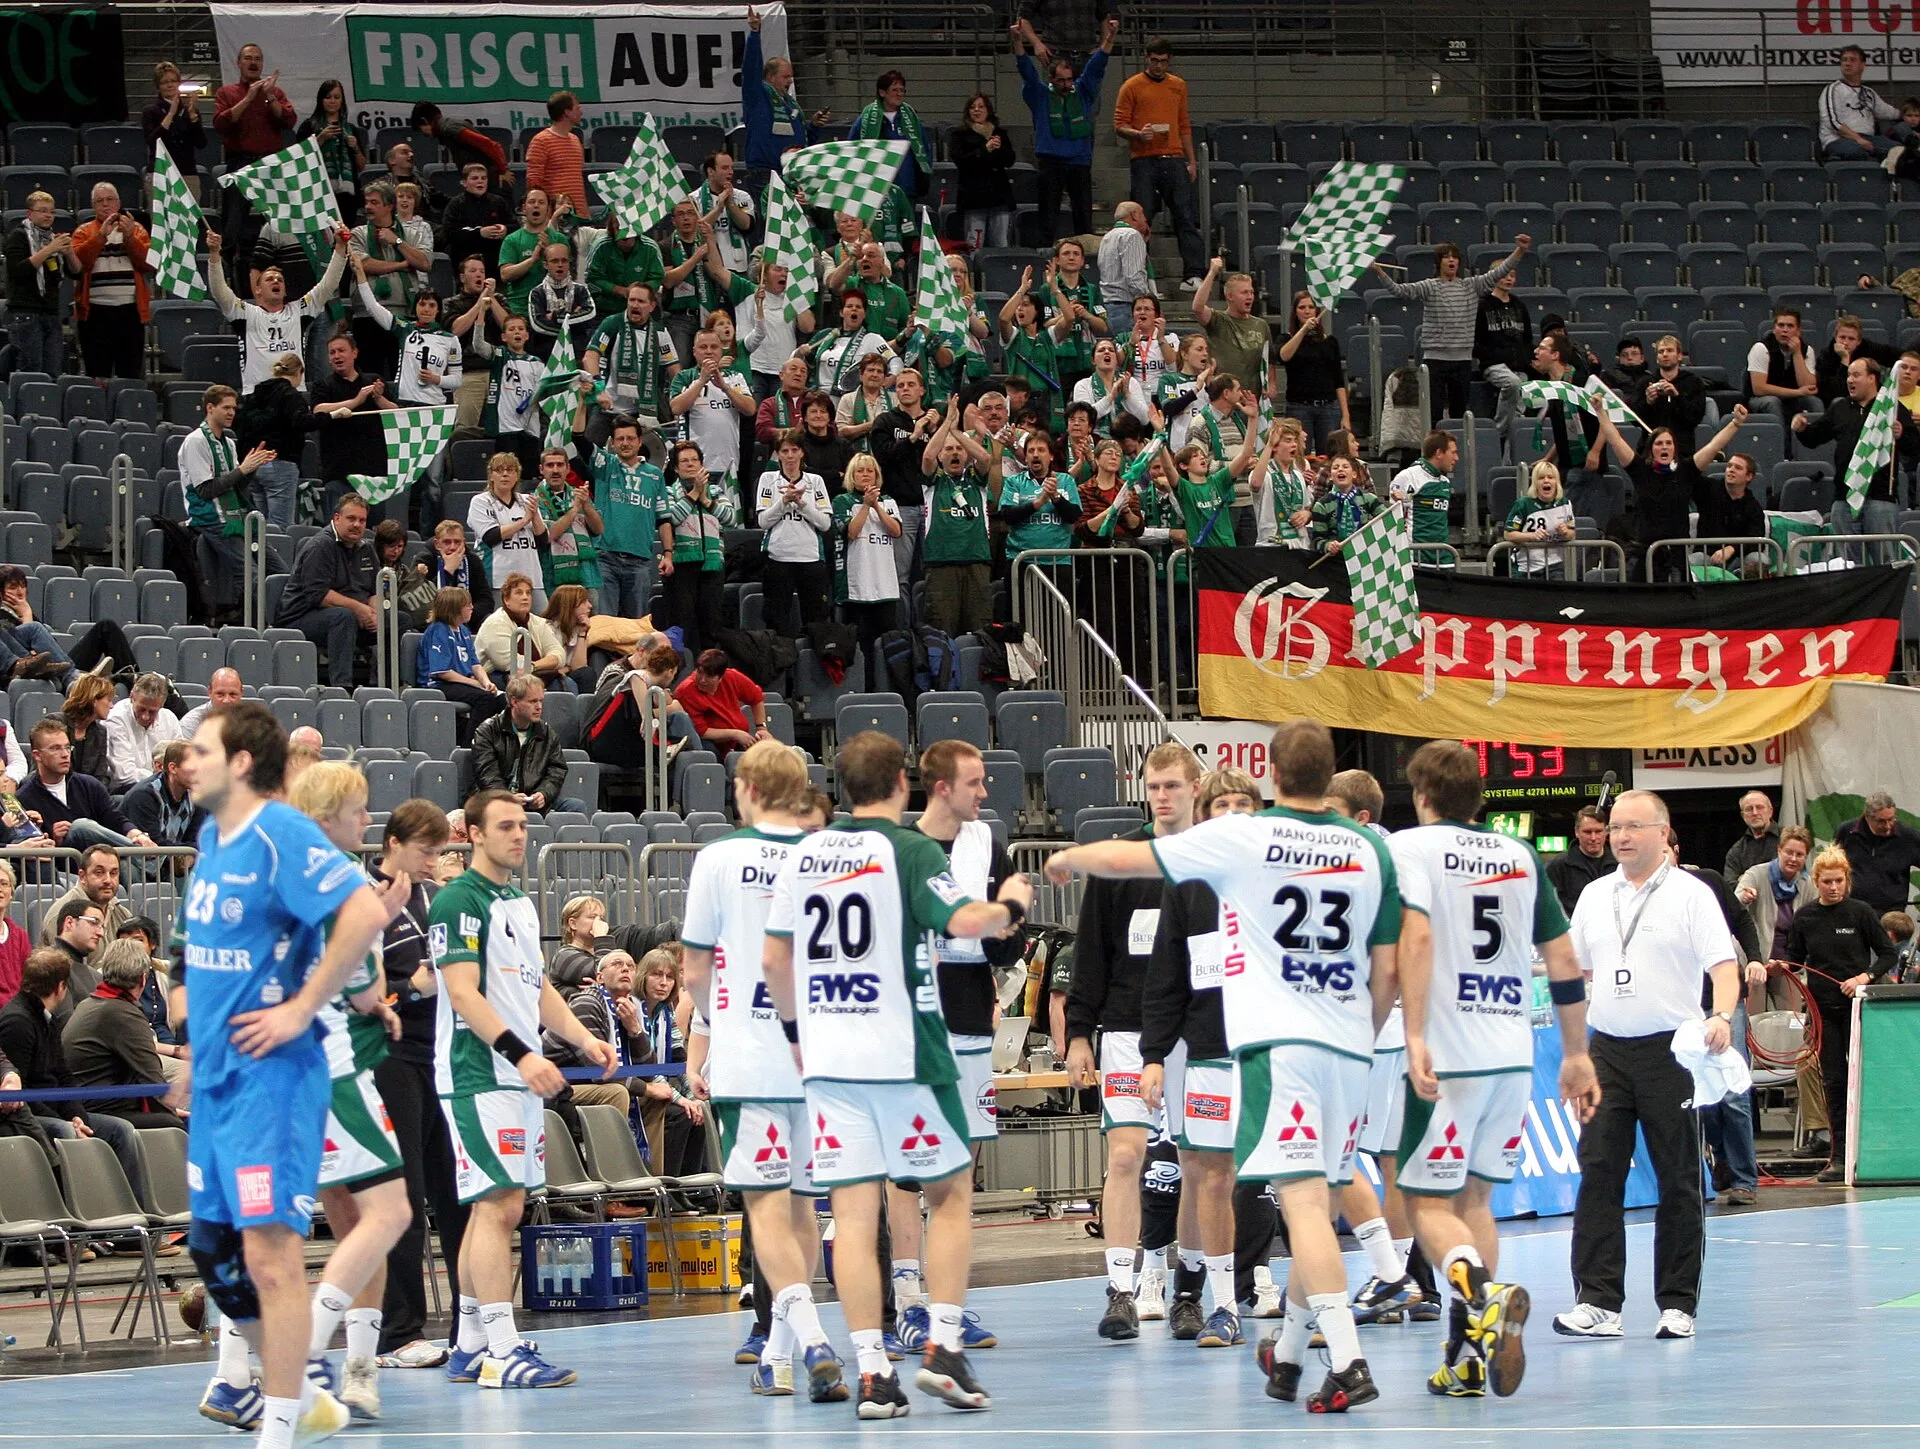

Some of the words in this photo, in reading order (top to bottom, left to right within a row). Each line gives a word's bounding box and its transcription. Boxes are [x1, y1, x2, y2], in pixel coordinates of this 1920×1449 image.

[363, 31, 585, 88] FRISCH
[609, 31, 744, 88] AUF!
[267, 327, 283, 340] 71
[269, 340, 296, 352] EnBW
[415, 350, 444, 367] EBW
[624, 476, 641, 492] 17
[609, 488, 652, 510] EnBW
[1526, 517, 1546, 533] 28
[1233, 576, 1856, 715] Gppingen
[1526, 787, 1549, 796] 42781
[1551, 786, 1576, 795] HAAN
[1272, 826, 1363, 849] MANOJLOVIC
[1456, 834, 1503, 850] OPREA
[799, 853, 874, 874] Divinol
[1265, 844, 1352, 869] Divinol
[1444, 852, 1517, 876] Divinol
[186, 878, 218, 924] 23
[804, 892, 873, 963] 20
[1273, 885, 1355, 953] 23
[1472, 894, 1505, 964] 5
[1281, 954, 1356, 991] EWS
[1615, 969, 1631, 985] D
[808, 973, 881, 1003] EWS
[1458, 972, 1523, 1005] EWS
[902, 1147, 941, 1159] MITSUBISHI
[1279, 1140, 1318, 1151] MITSUBISHI
[1285, 1151, 1315, 1160] MOTORS
[910, 1157, 937, 1167] MOTORS
